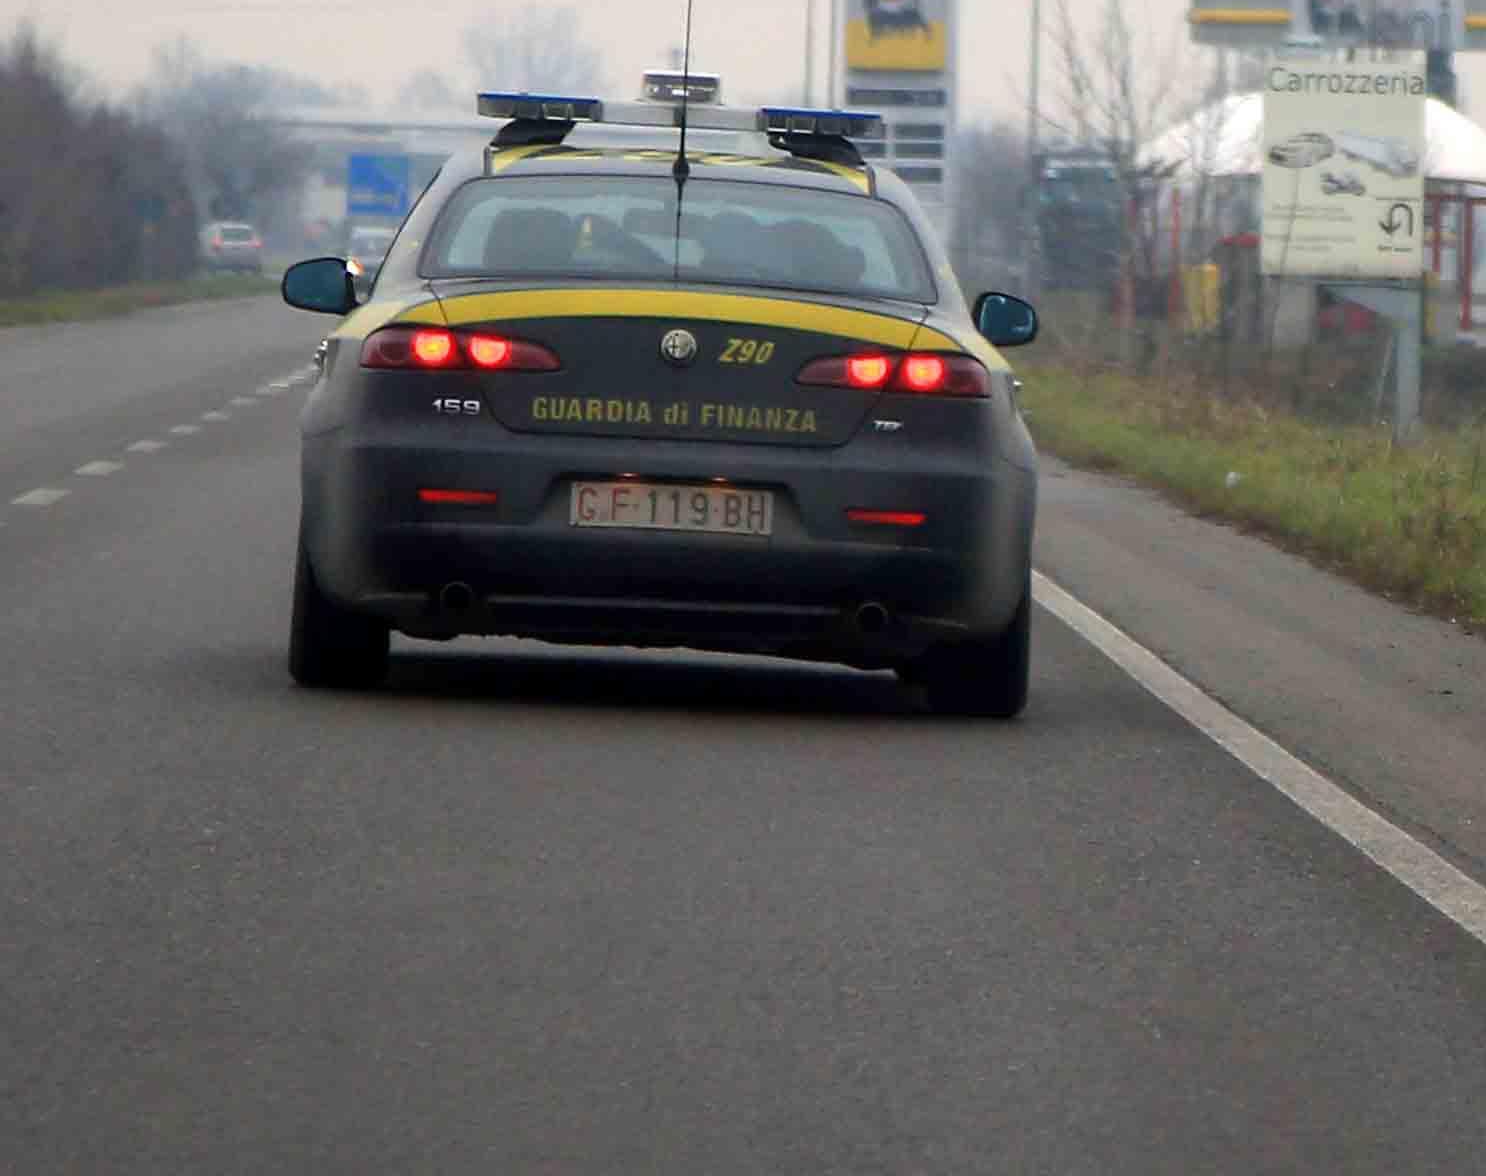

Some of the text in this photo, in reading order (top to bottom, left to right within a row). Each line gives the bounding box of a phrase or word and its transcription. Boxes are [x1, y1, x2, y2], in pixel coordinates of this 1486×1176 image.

[1269, 66, 1425, 96] Carrozzeria
[718, 338, 775, 364] Z90
[431, 398, 481, 416] 159
[531, 396, 818, 433] GUARDIA di FINANZA
